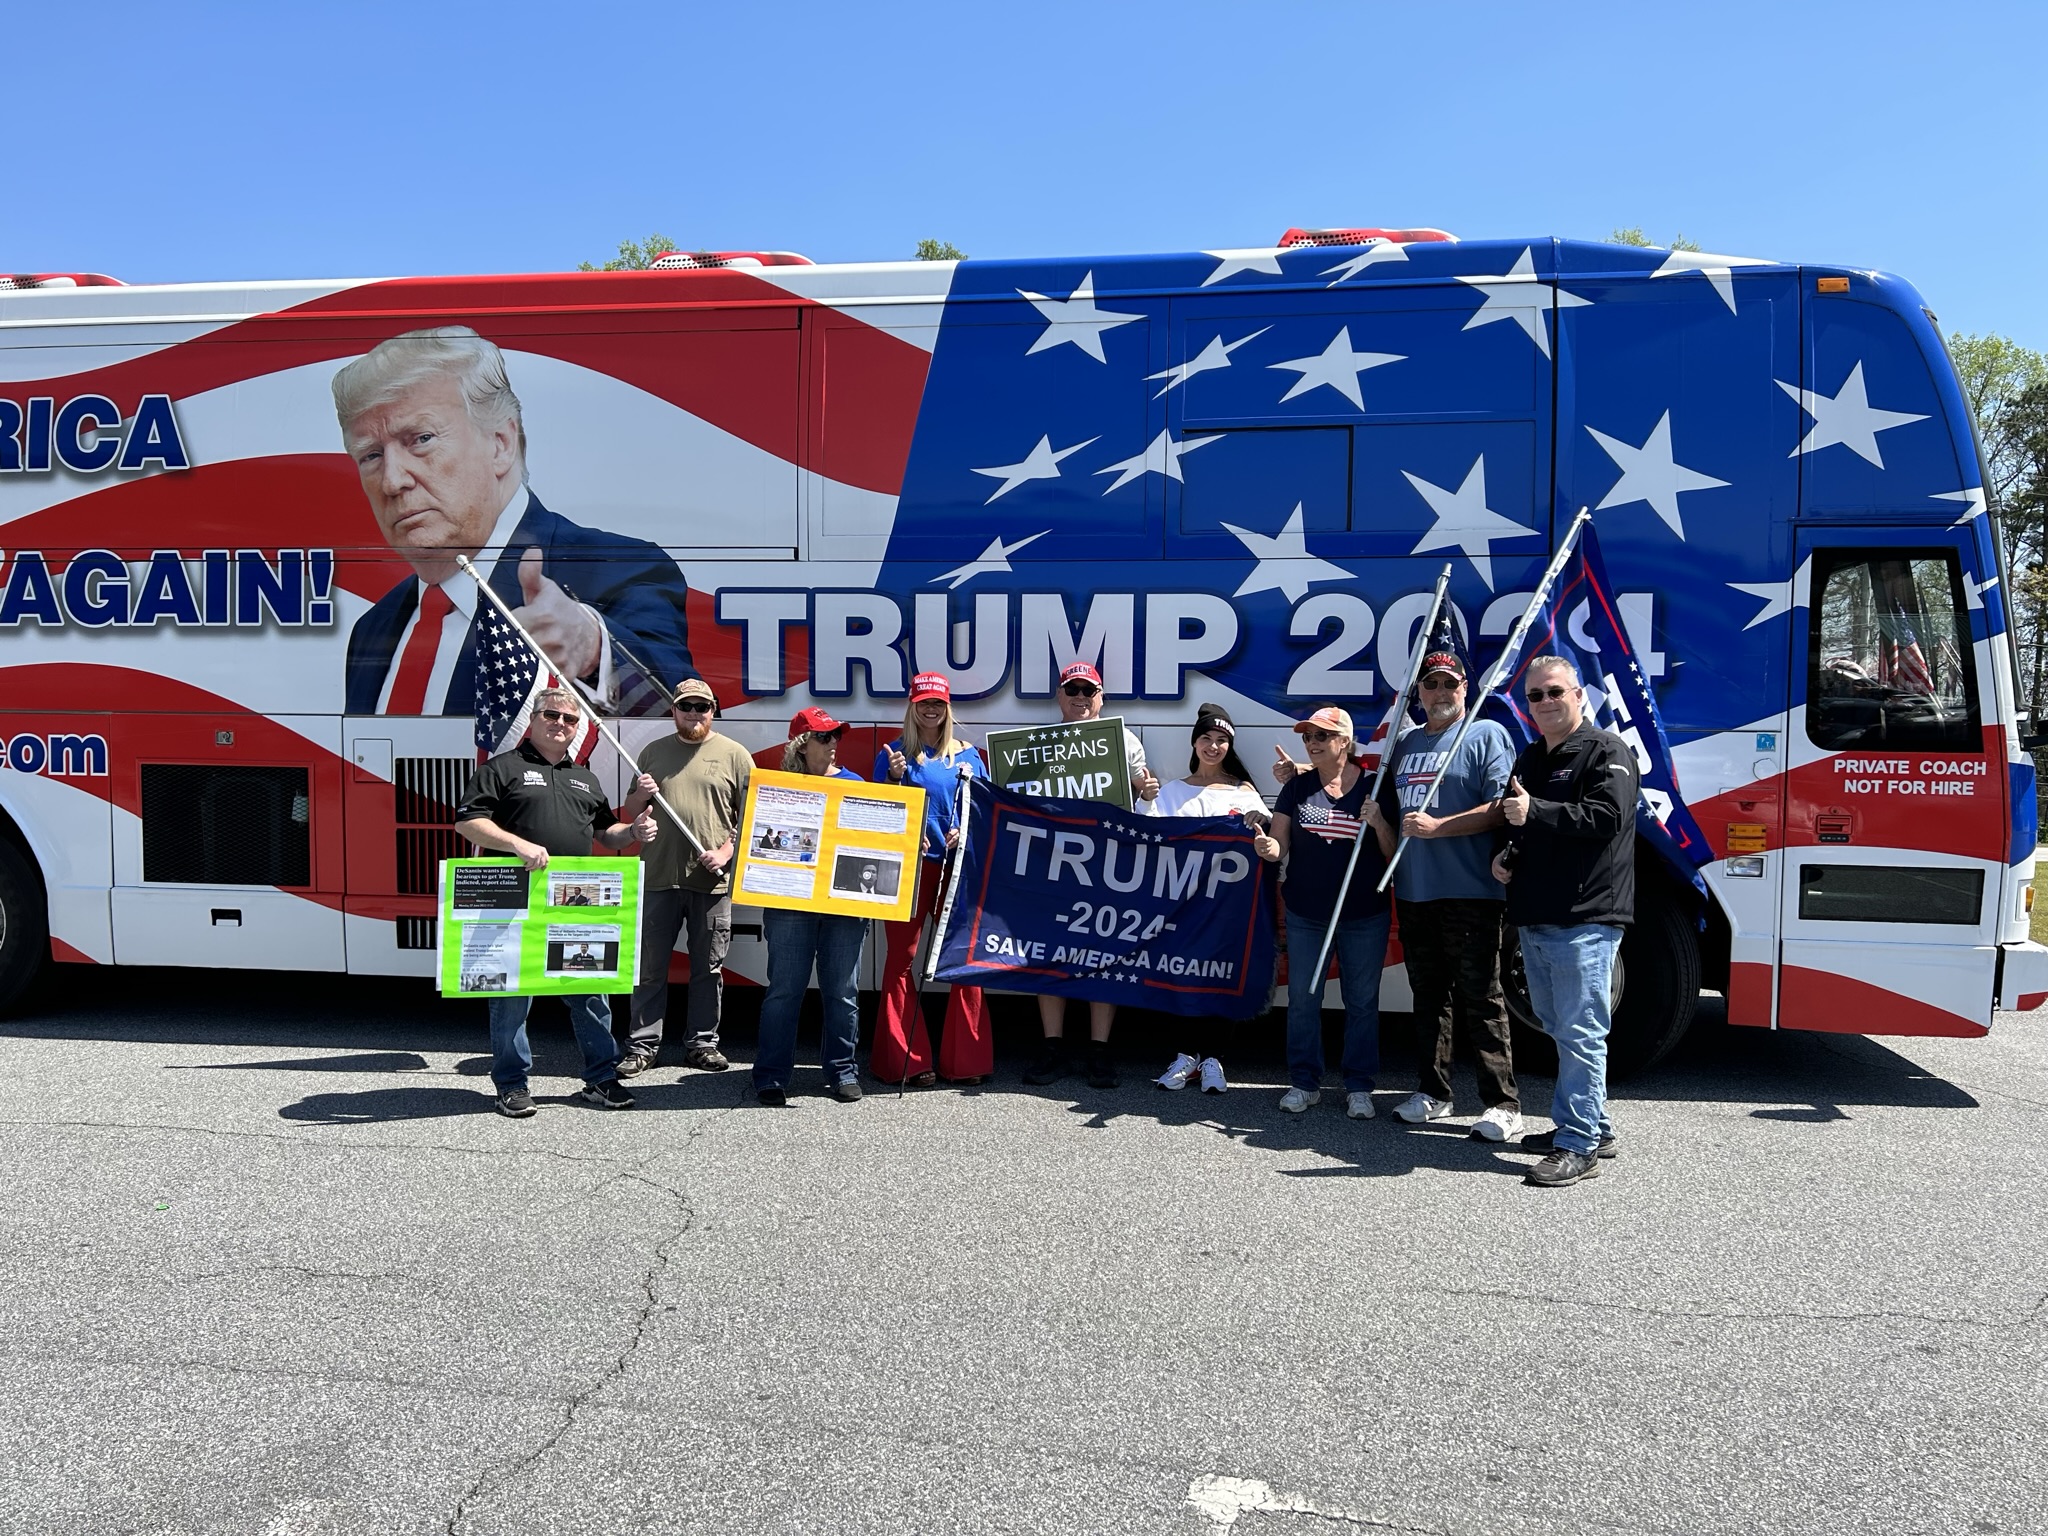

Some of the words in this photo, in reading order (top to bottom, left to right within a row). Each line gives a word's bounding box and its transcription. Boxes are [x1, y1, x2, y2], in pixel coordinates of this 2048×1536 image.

[0, 548, 335, 628] AGAIN!
[717, 590, 1241, 696] TRUMP
[914, 676, 928, 684] MAKE
[1214, 718, 1235, 737] TRUM
[0, 732, 109, 776] om
[1003, 738, 1109, 767] VETERANS
[1396, 751, 1450, 776] ULTRA
[1049, 764, 1067, 774] FOR
[1834, 759, 1910, 774] PRIVATE
[1919, 760, 1987, 775] COACH
[1006, 772, 1113, 799] TRUMP
[1844, 780, 1883, 794] NOT
[1887, 780, 1926, 795] FOR
[1930, 781, 1974, 795] HIRE
[1005, 821, 1250, 901] TRUMP
[984, 934, 1046, 961] SAVE
[1156, 953, 1234, 980] AGAIN!
